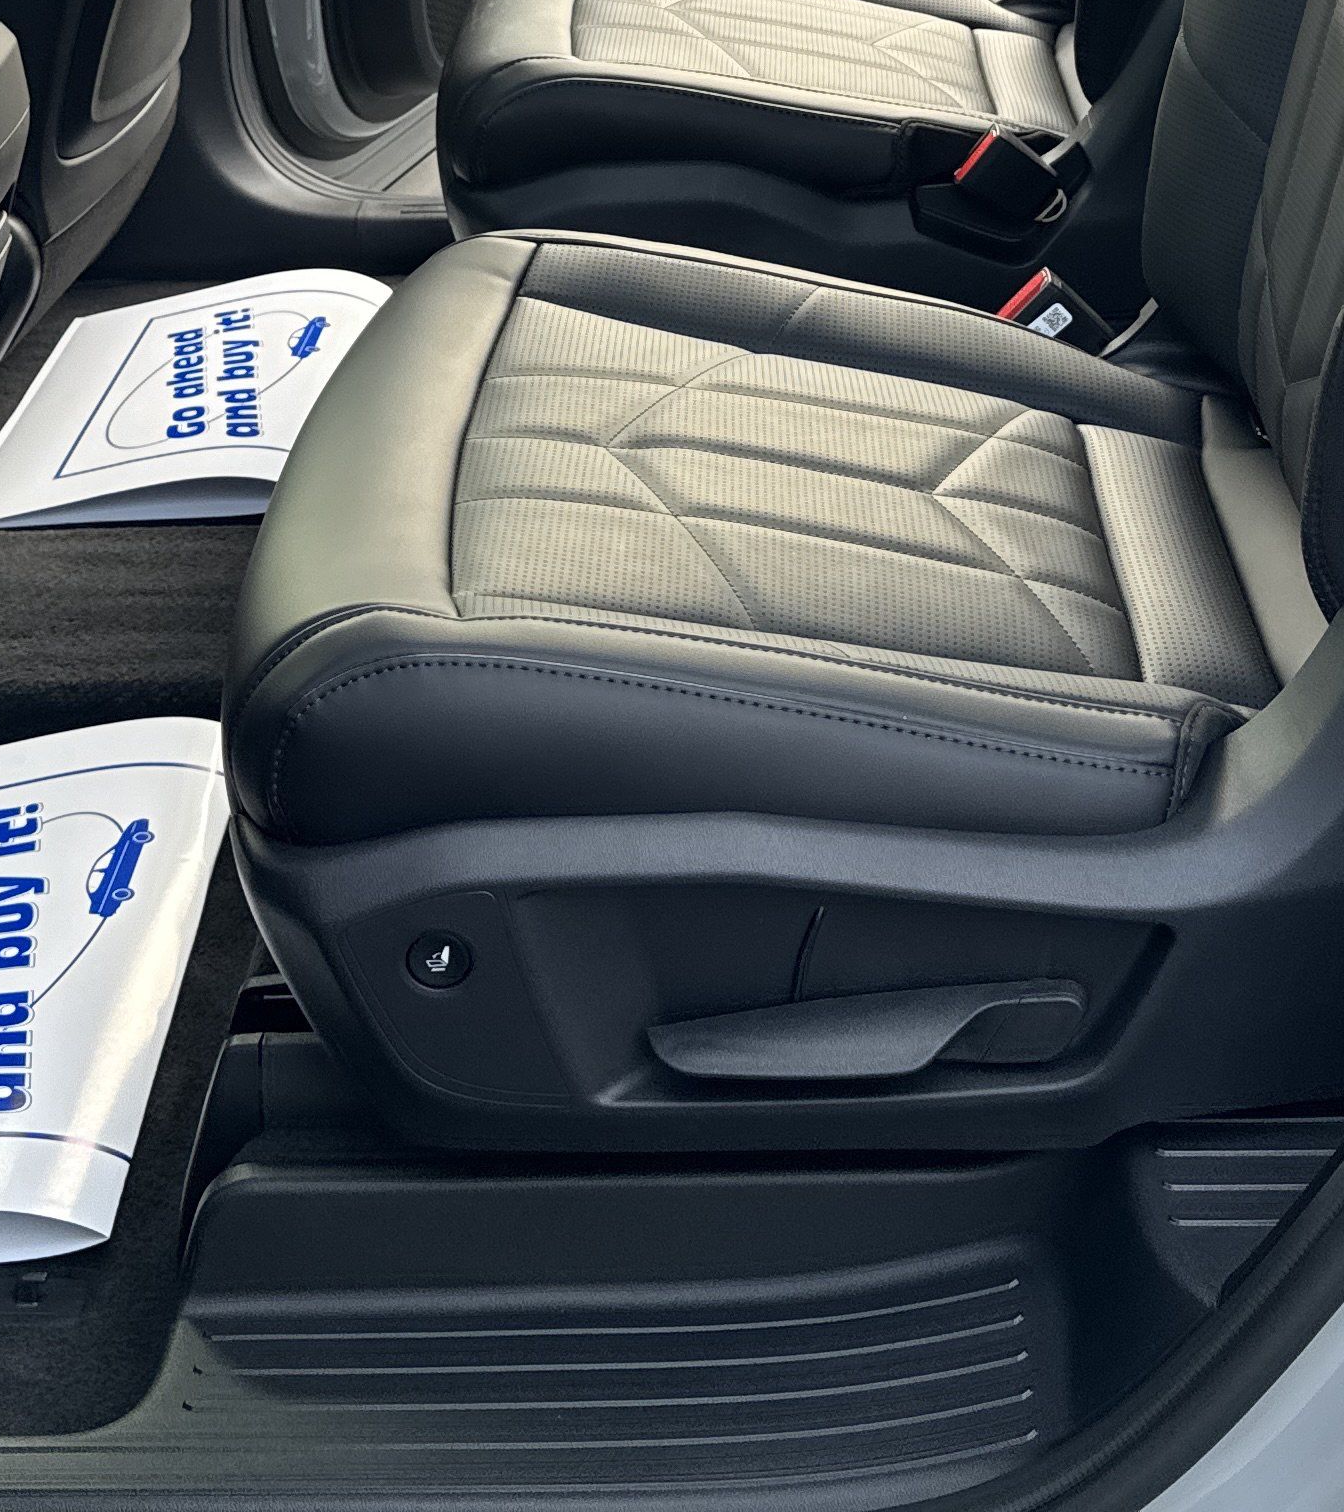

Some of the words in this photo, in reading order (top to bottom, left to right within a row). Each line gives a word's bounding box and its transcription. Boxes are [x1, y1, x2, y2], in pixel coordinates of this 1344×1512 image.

[213, 306, 253, 335] it!
[167, 326, 208, 400] ahead
[217, 338, 260, 381] buy
[166, 405, 208, 439] Go
[217, 387, 262, 438] and
